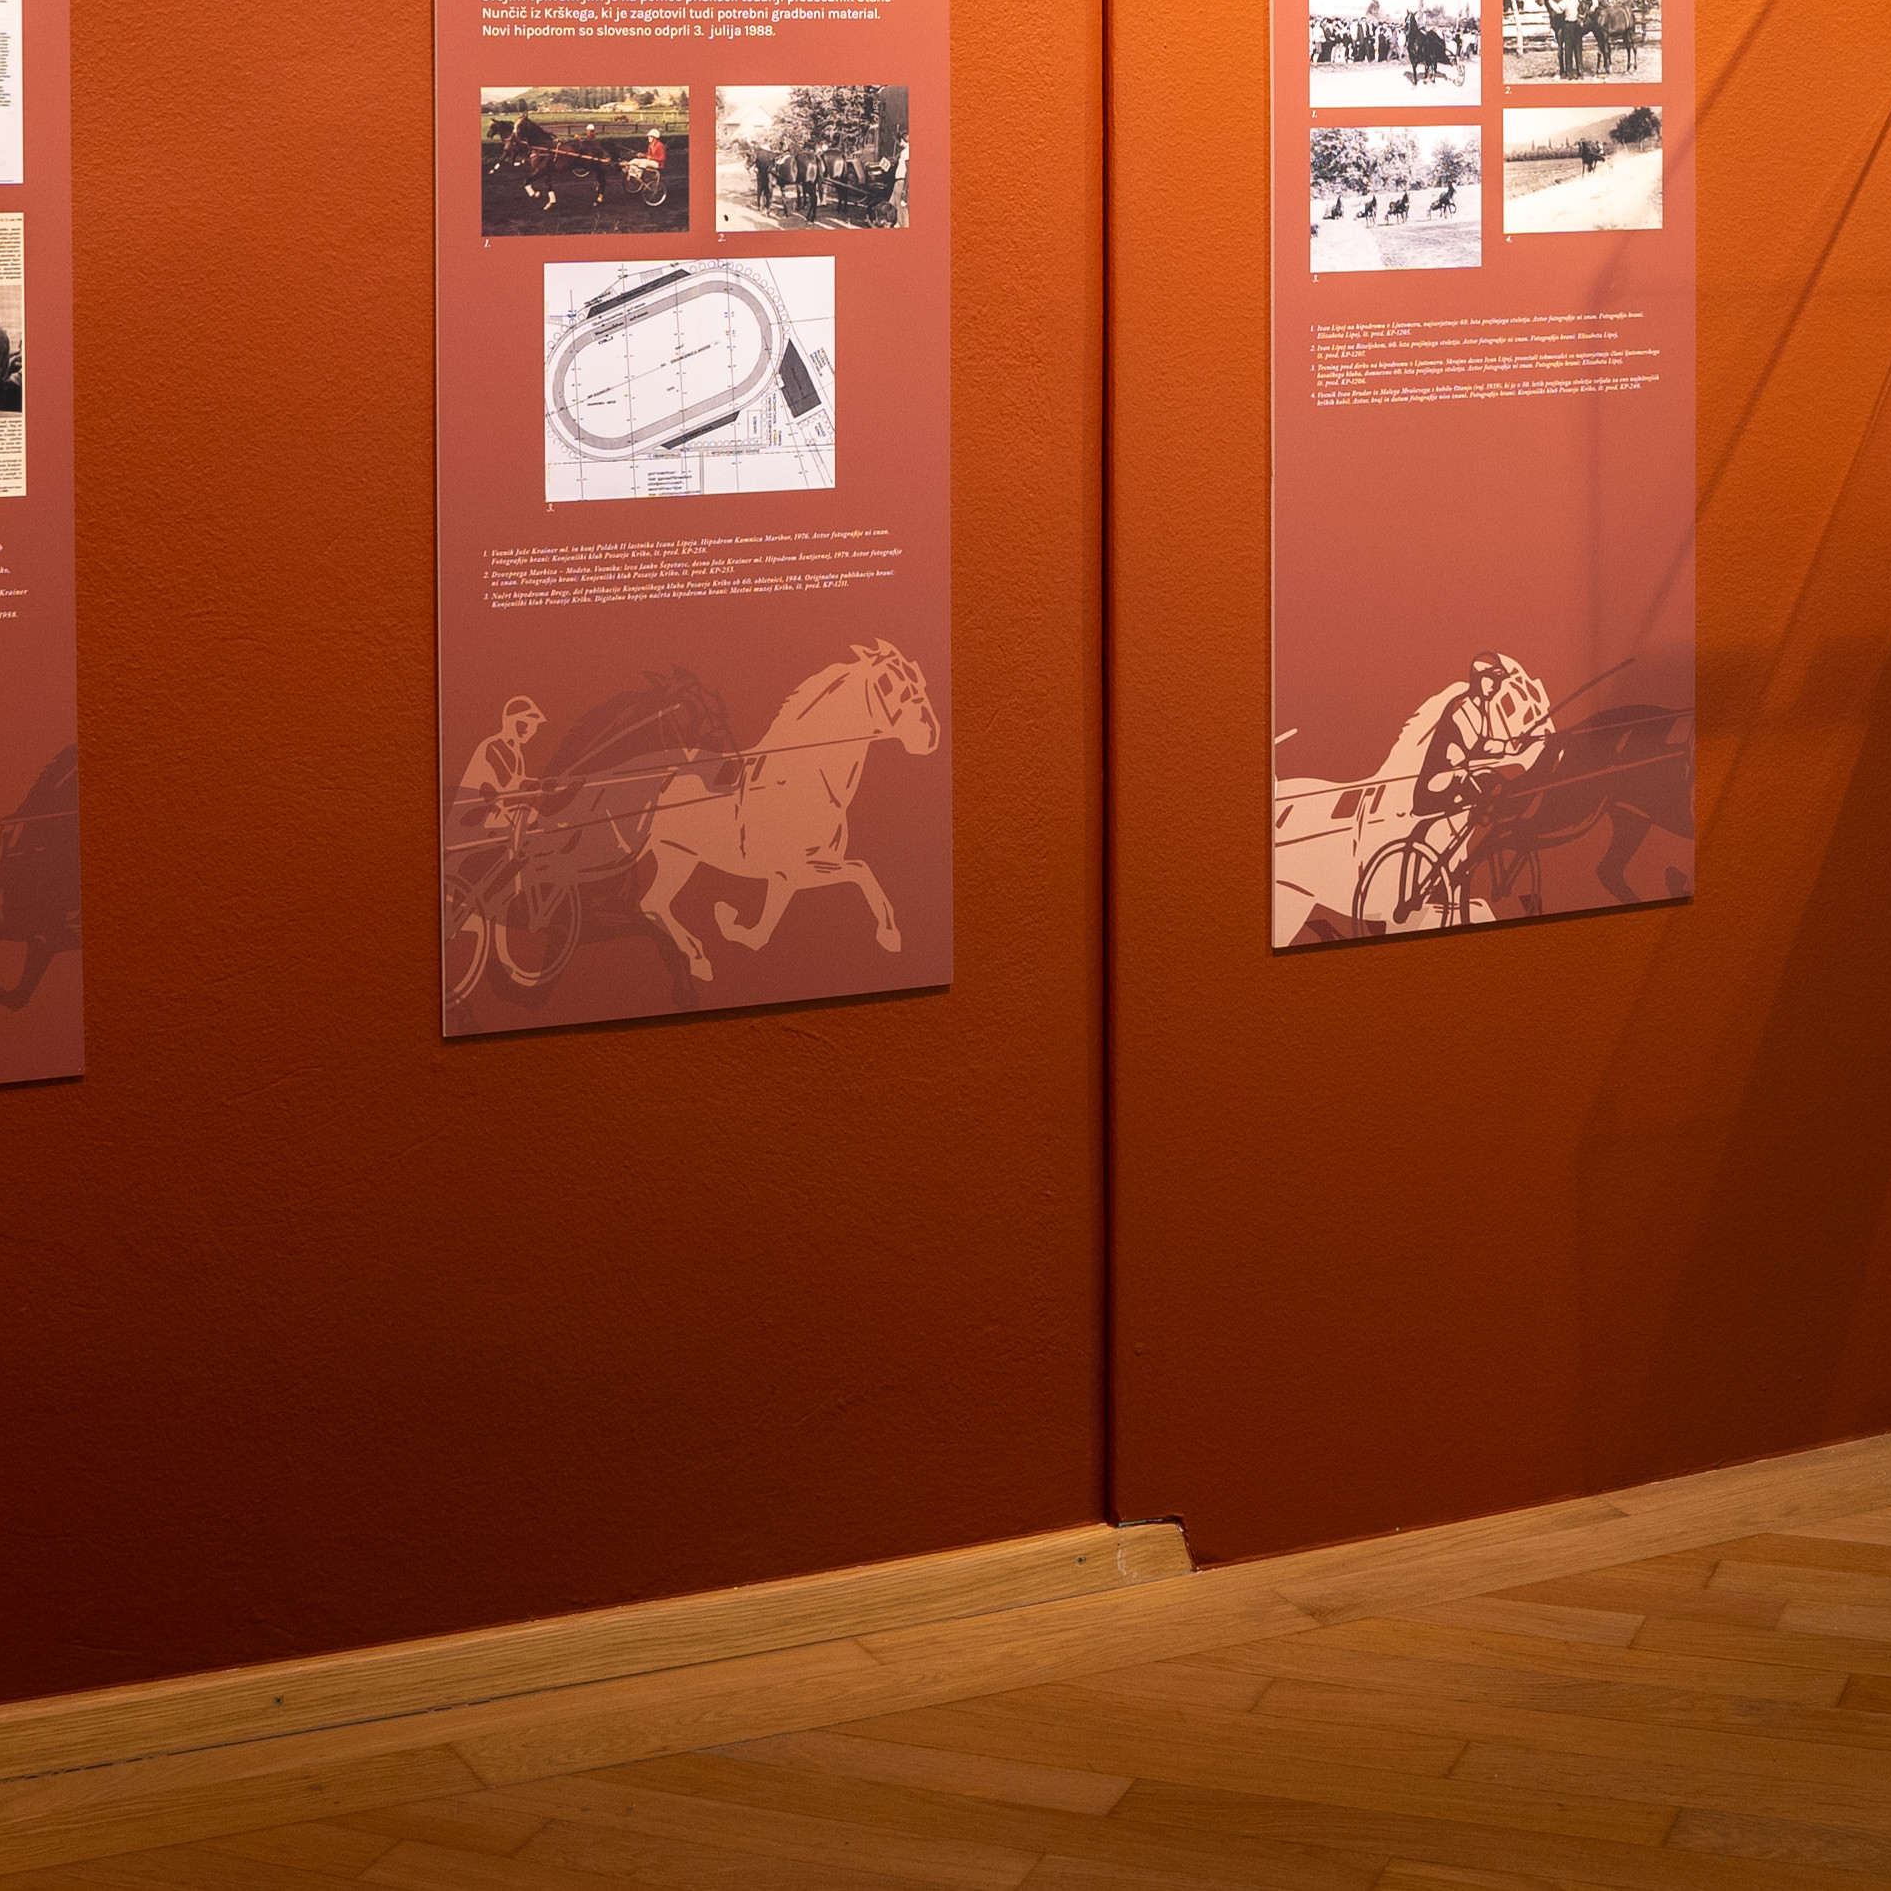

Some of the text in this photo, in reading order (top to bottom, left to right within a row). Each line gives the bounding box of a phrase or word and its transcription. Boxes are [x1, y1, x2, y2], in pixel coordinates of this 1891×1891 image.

[483, 24, 775, 39] Novi hipodrom so slovesno odprli 3. julija 1988.
